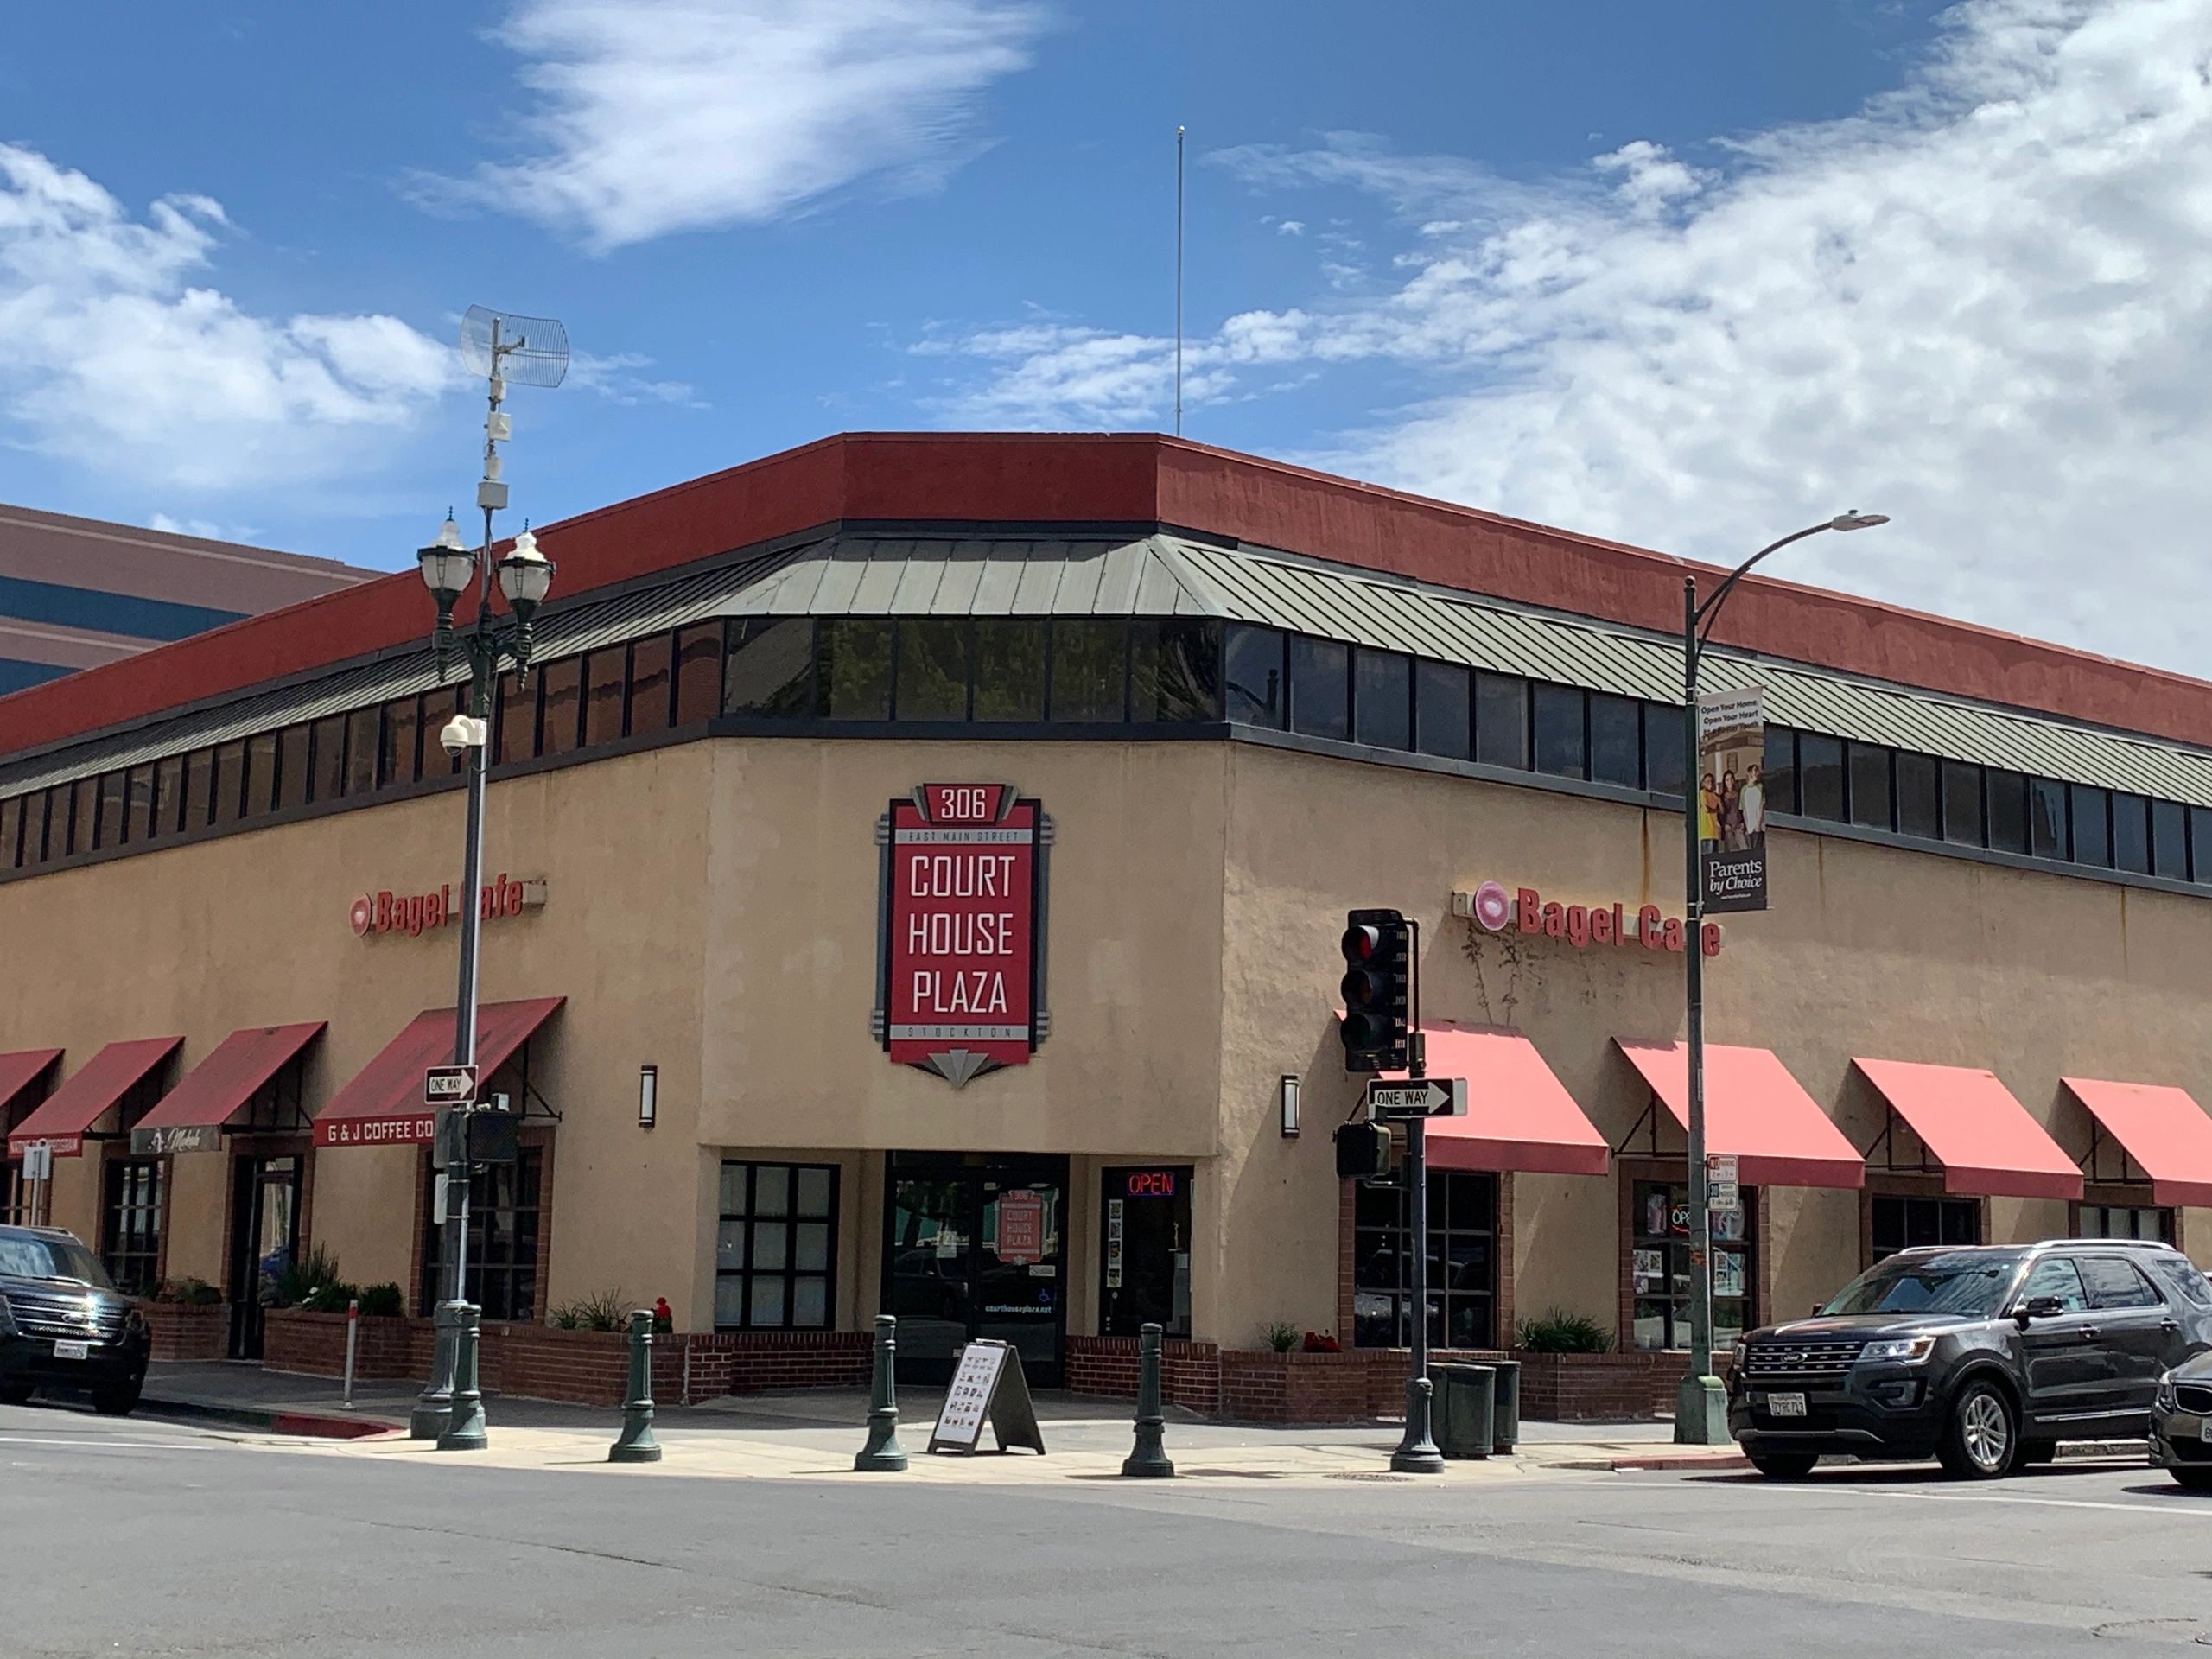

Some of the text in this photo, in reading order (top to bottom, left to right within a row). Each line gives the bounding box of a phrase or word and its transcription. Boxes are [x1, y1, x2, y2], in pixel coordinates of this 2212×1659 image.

[1701, 706, 1719, 715] Open
[1704, 716, 1722, 725] Open
[1739, 710, 1758, 719] Heart
[941, 789, 987, 819] 306
[909, 831, 1019, 842] EAST MAIN STREET
[910, 855, 1016, 897] COURT
[1709, 860, 1763, 878] Parents
[1709, 874, 1763, 895] by Choice
[376, 873, 524, 938] Bagel afe
[1518, 887, 1720, 956] Bagel Cae
[908, 912, 1013, 955] HOUSE
[912, 971, 1007, 1014] PLAZA
[908, 1027, 1011, 1038] STOCKTON
[431, 1077, 461, 1091] ONE WAY
[1377, 1090, 1428, 1105] ONE WAY
[327, 1125, 337, 1141] G
[340, 1124, 349, 1141] &
[353, 1123, 360, 1141] J
[364, 1122, 411, 1140] COFFEE
[1128, 1173, 1173, 1195] OPEN
[1007, 1211, 1033, 1221] COURT
[1007, 1222, 1033, 1233] HOUSE
[1007, 1235, 1033, 1245] PLAZA
